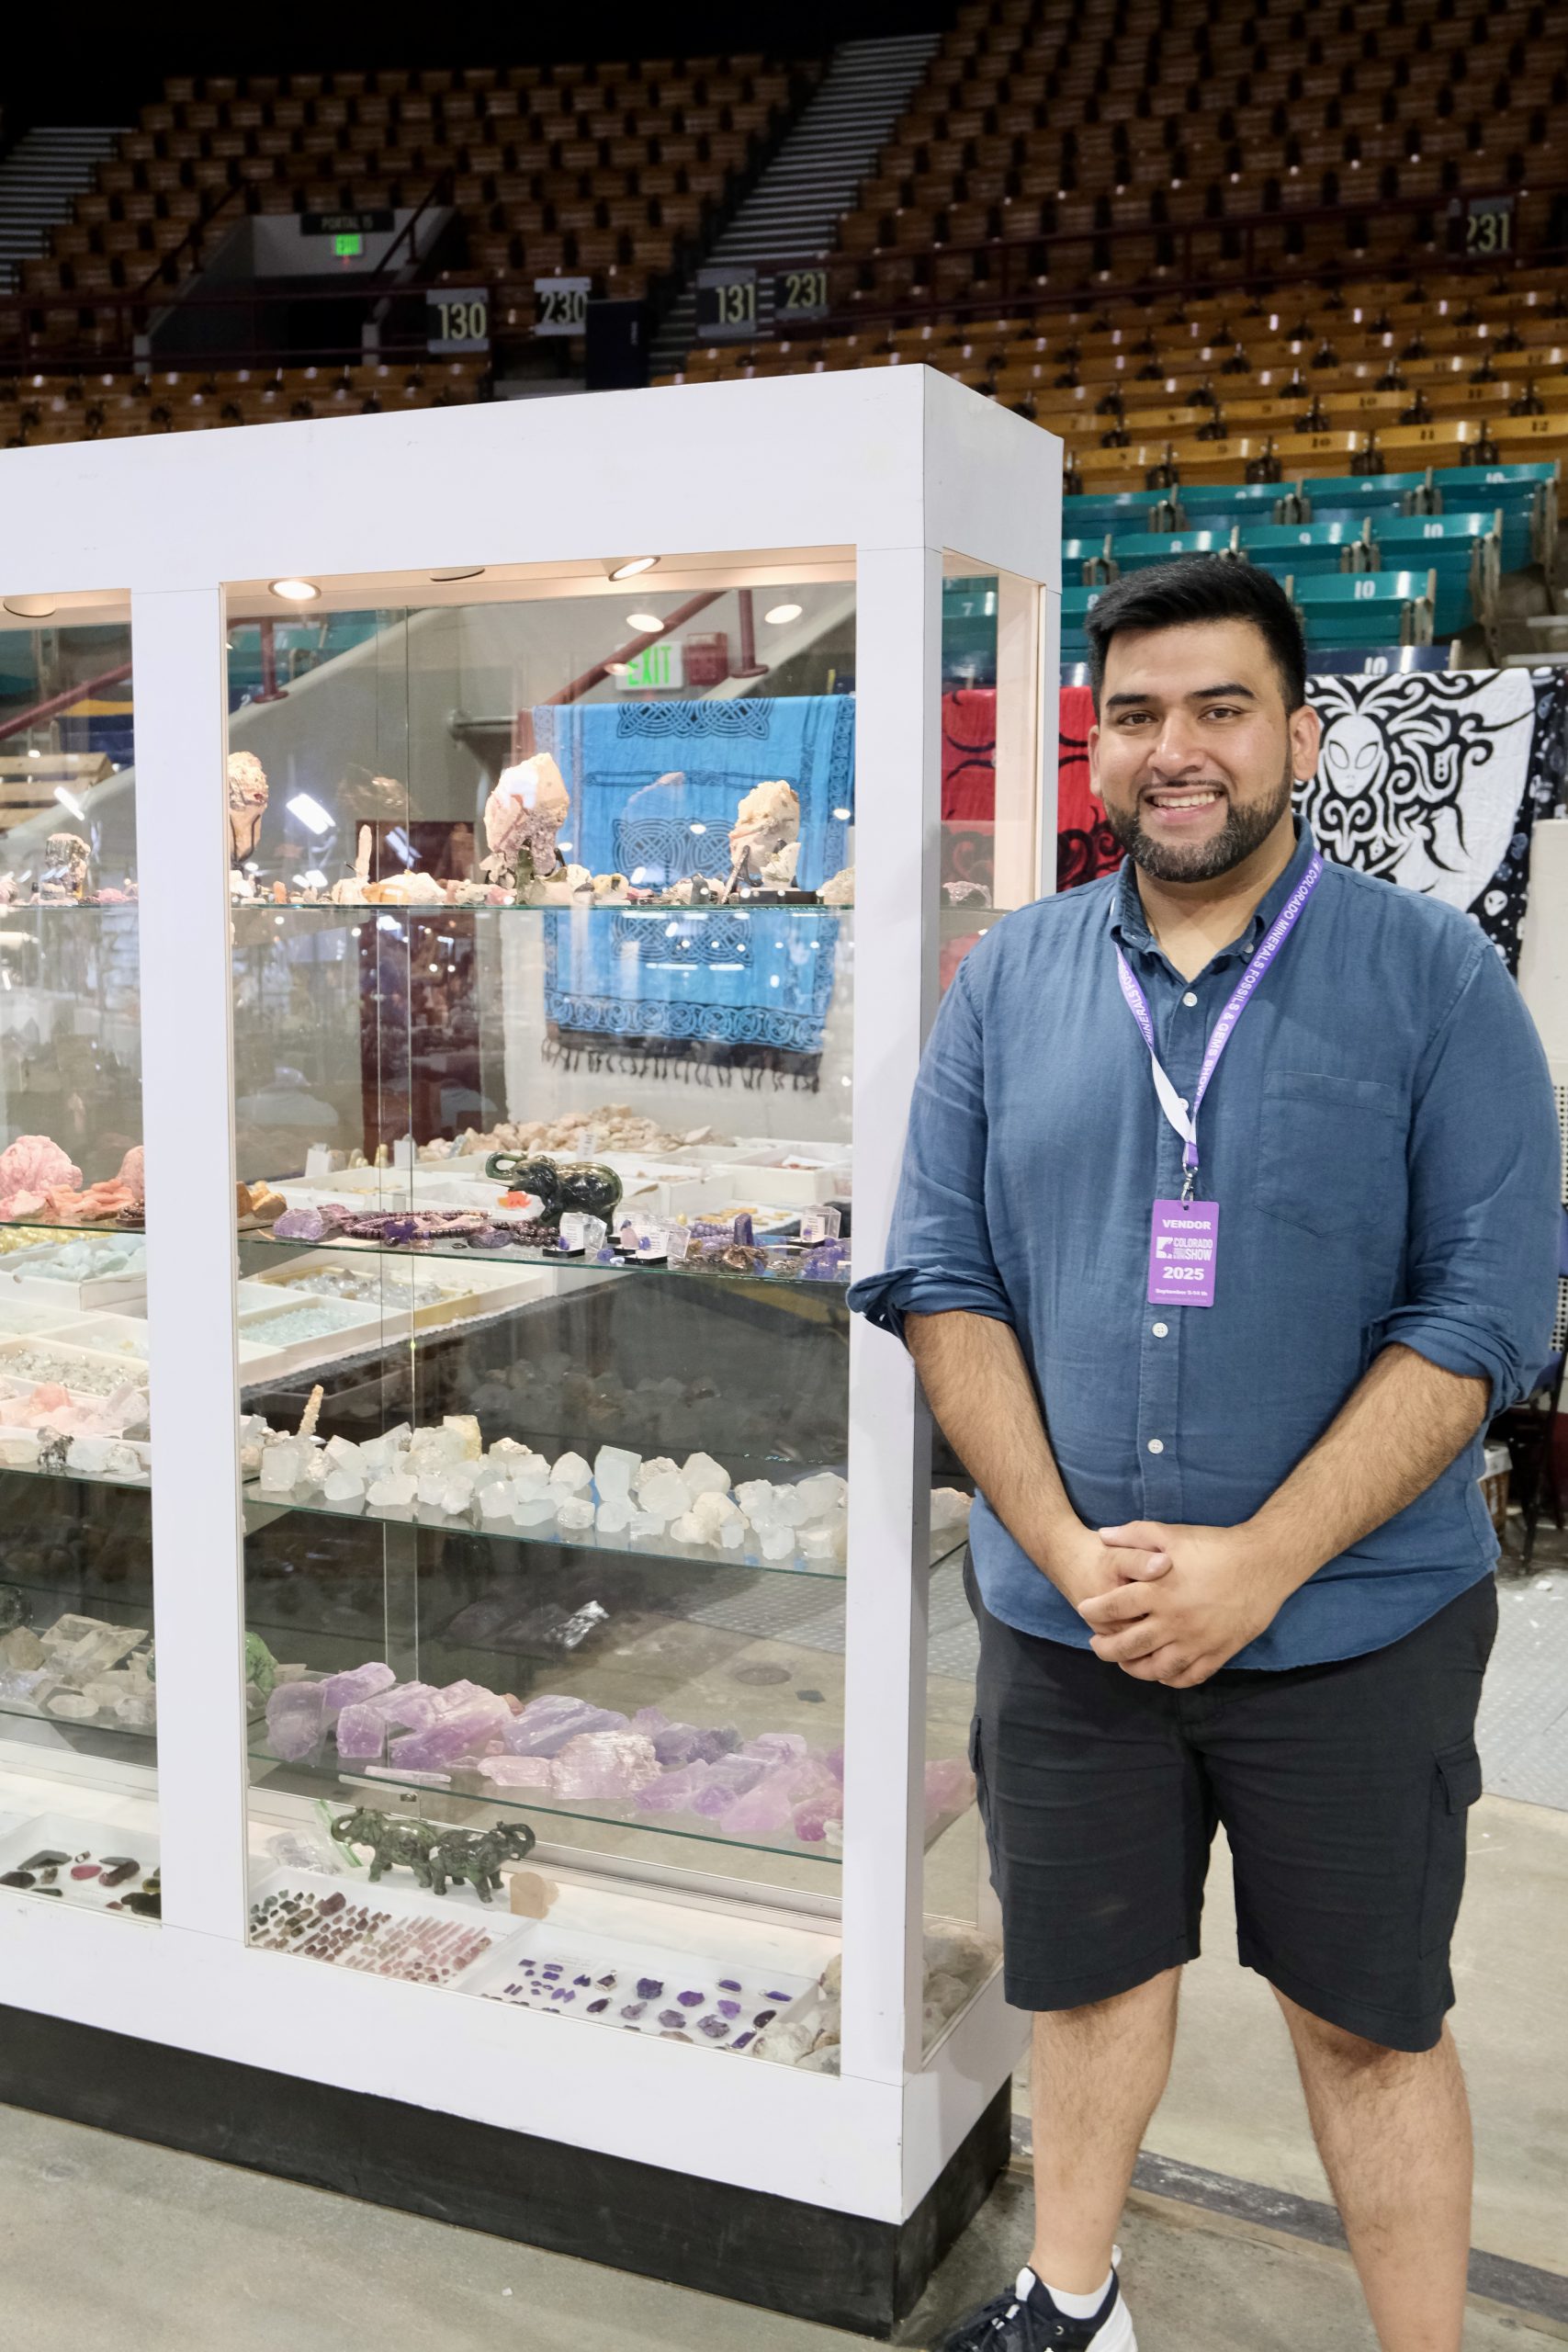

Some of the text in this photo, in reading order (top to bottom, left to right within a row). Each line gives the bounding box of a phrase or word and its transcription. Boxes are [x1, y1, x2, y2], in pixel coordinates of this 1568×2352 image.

[541, 290, 588, 324] 230
[716, 283, 755, 323] 131
[785, 273, 827, 308] 231
[438, 302, 487, 340] 130
[1424, 524, 1444, 537] 10
[1354, 581, 1376, 599] 10
[627, 646, 671, 685] EXIT
[1364, 657, 1388, 675] 10
[1284, 869, 1317, 919] COLORADO
[1253, 919, 1289, 968] MINERALS
[1229, 968, 1259, 1011] FOSSILS
[1207, 1023, 1229, 1057] GEMS
[1162, 1219, 1211, 1229] VENDOR
[1173, 1238, 1213, 1249] COLORADO
[1185, 1249, 1212, 1261] SHOW
[1163, 1267, 1204, 1281] 2025
